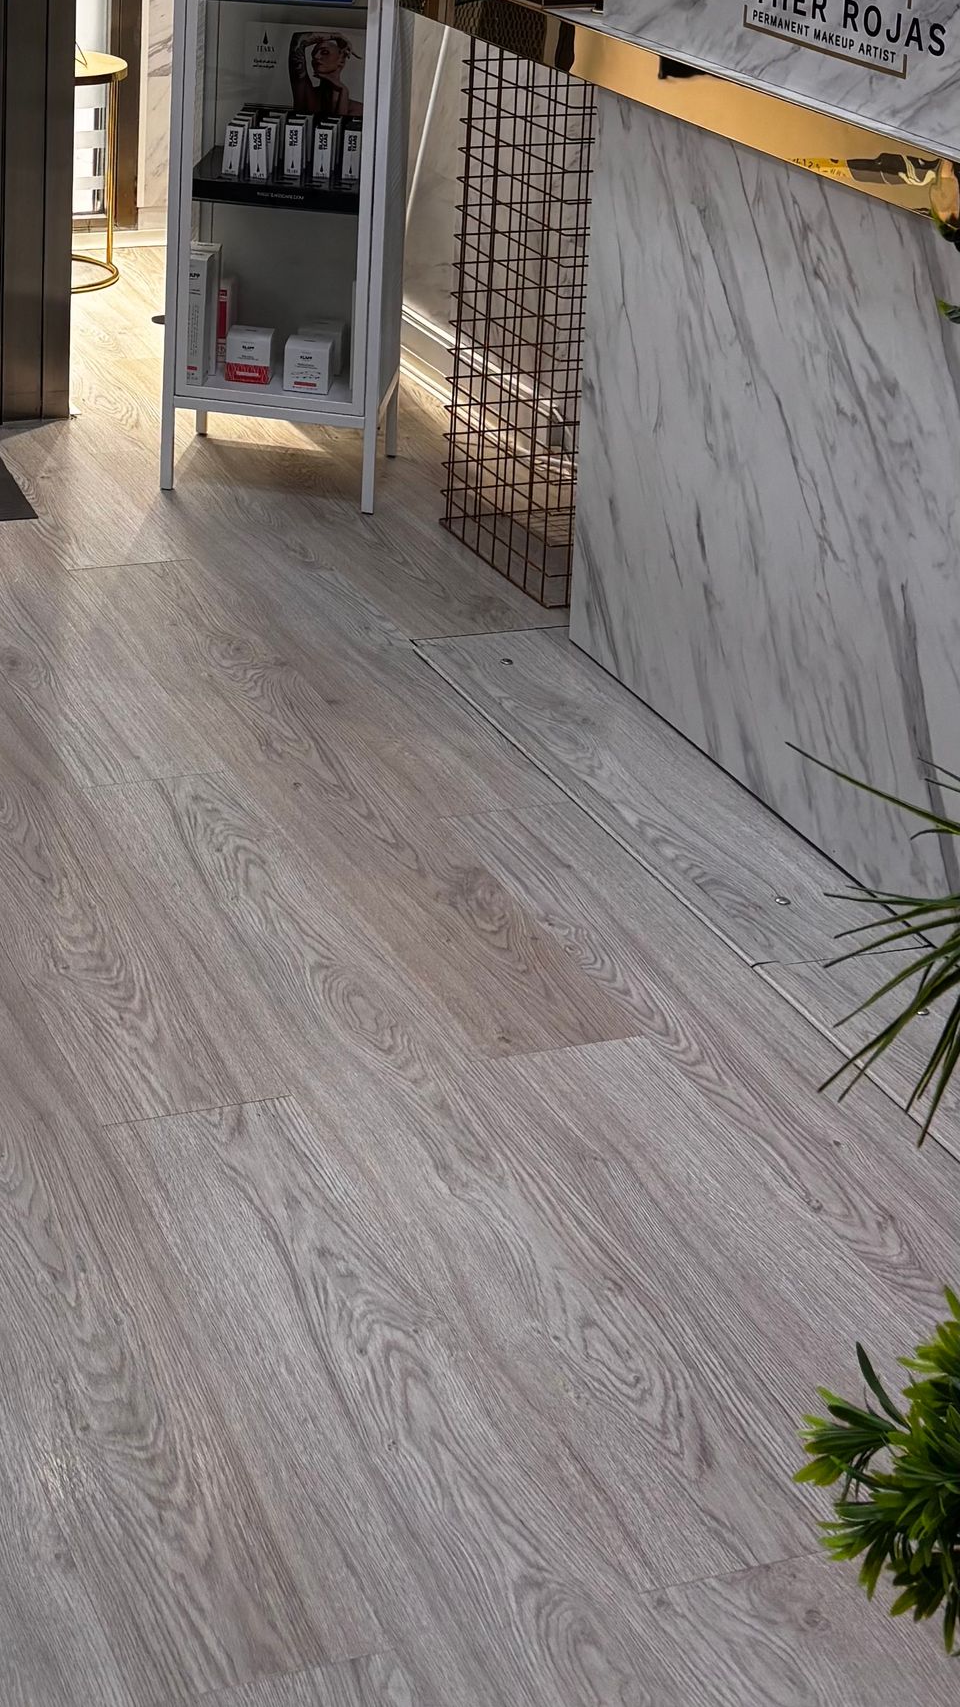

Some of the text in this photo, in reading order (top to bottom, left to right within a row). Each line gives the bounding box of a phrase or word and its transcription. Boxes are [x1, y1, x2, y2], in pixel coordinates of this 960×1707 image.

[751, 9, 897, 64] PERMANENT MAKEUP ARTIST
